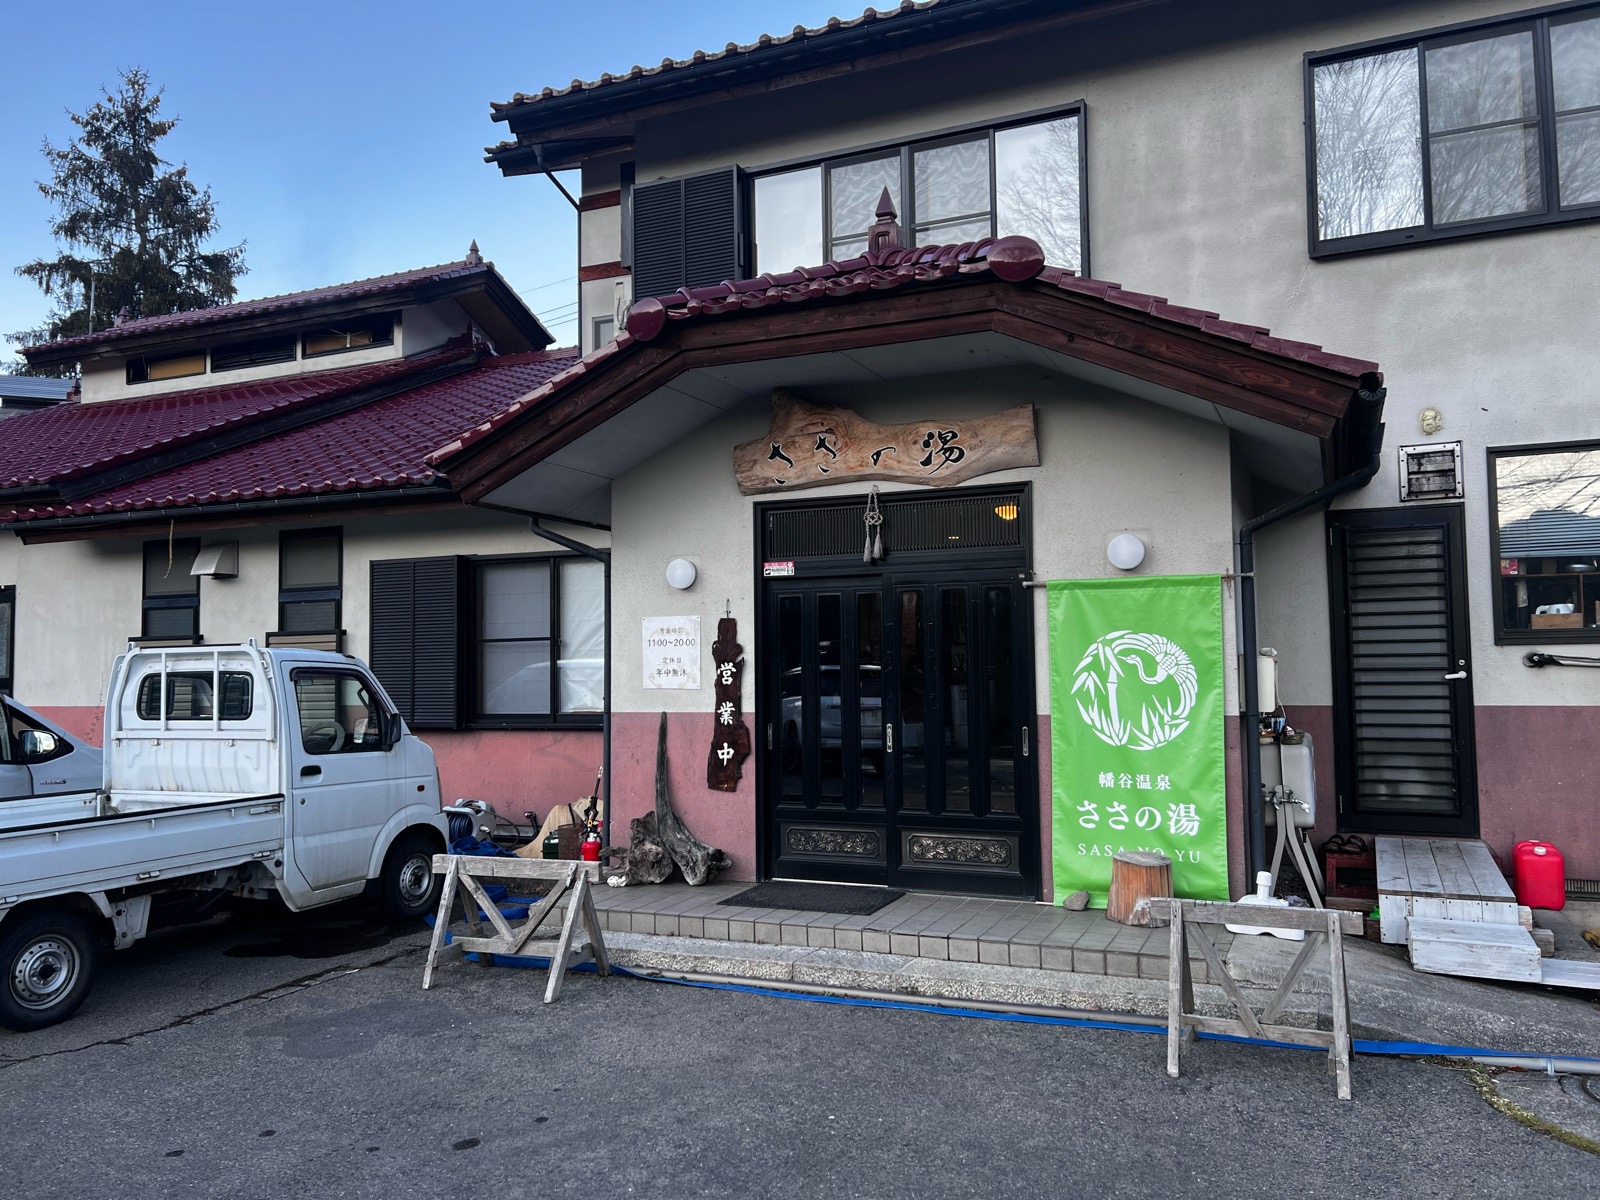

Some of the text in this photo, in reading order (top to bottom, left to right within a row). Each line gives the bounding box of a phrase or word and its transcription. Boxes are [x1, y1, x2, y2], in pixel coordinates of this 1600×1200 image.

[767, 429, 966, 485] ささの湯
[662, 656, 682, 665] 定休日
[717, 662, 737, 767] 営業中
[1098, 771, 1172, 791] 幡谷温泉
[1076, 800, 1201, 836] ささの湯
[1175, 849, 1200, 864] YU
